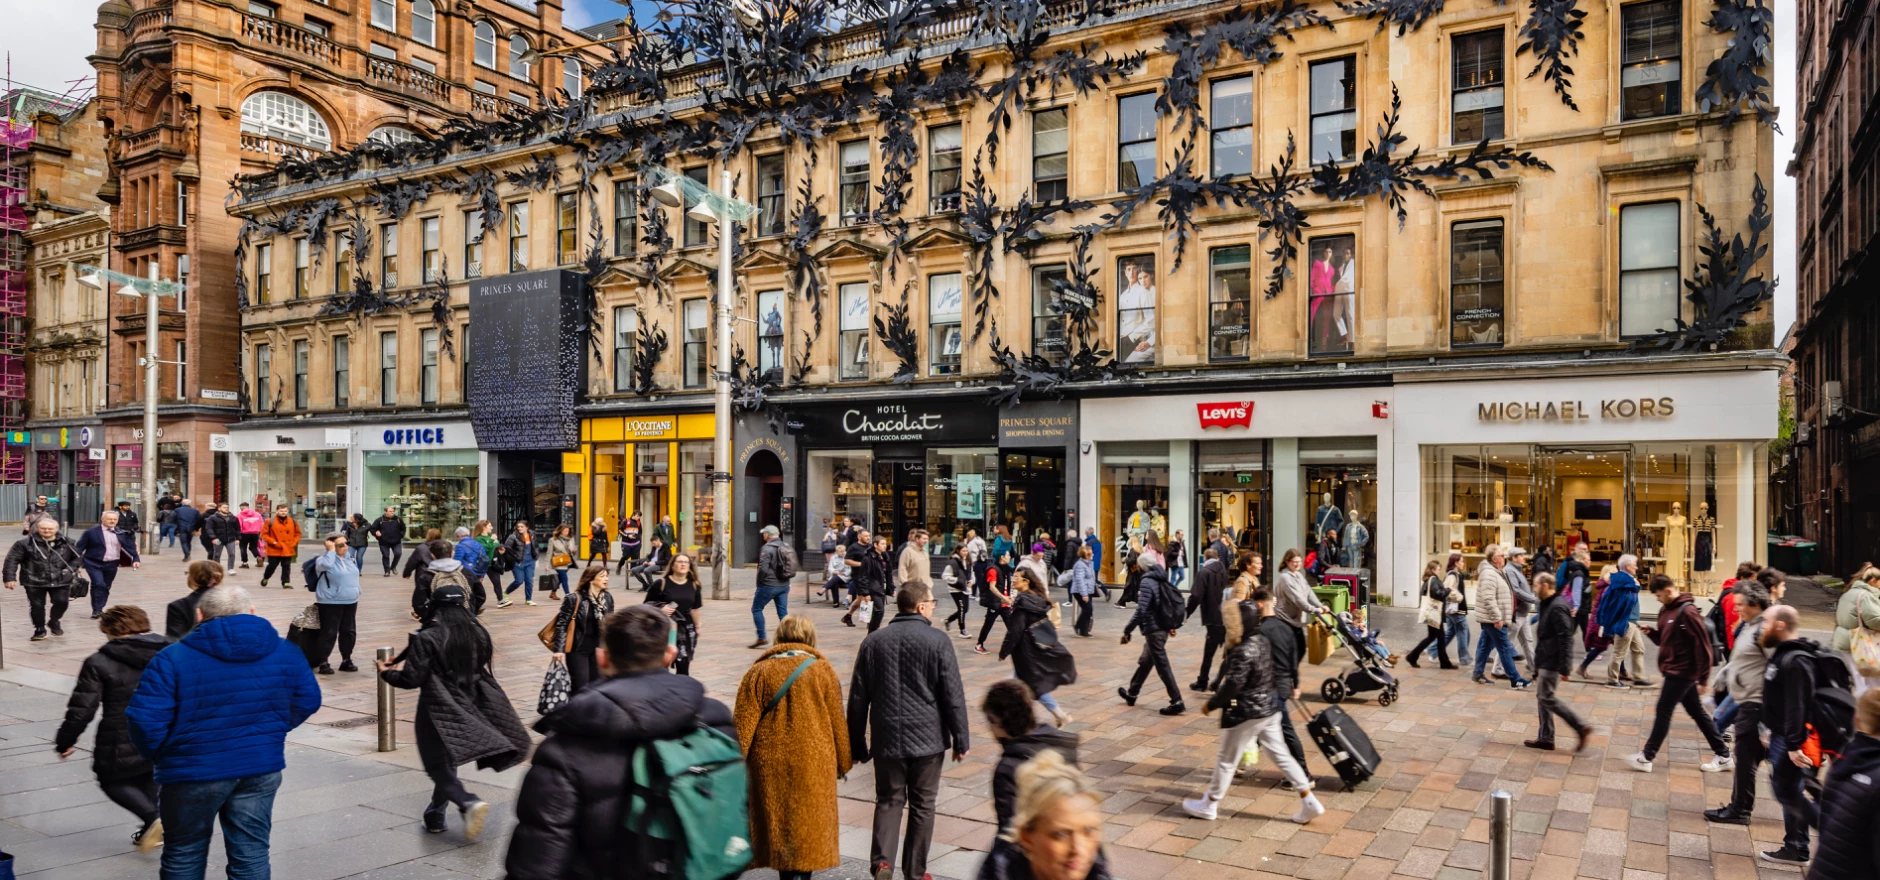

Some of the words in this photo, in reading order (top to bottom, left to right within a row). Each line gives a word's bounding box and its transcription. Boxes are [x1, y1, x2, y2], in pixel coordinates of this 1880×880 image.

[480, 283, 512, 296] PRINCES
[517, 278, 549, 292] SQUARE
[1456, 312, 1500, 320] CONNECTION
[877, 405, 907, 414] HOTEL
[1478, 400, 1590, 421] MICHAEL
[1600, 396, 1675, 419] KORS
[627, 420, 673, 432] L'OCCITANE
[842, 409, 944, 434] Chocolat.
[1000, 418, 1036, 428] PRINCES
[1038, 416, 1073, 427] SQUARE
[383, 427, 445, 445] OFFICE
[861, 434, 880, 442] BRITISH
[900, 433, 923, 441] GROWER
[1005, 430, 1036, 438] SHOPPING
[1036, 429, 1042, 437] &
[739, 437, 764, 463] PRINCES
[765, 437, 790, 464] SQUARE
